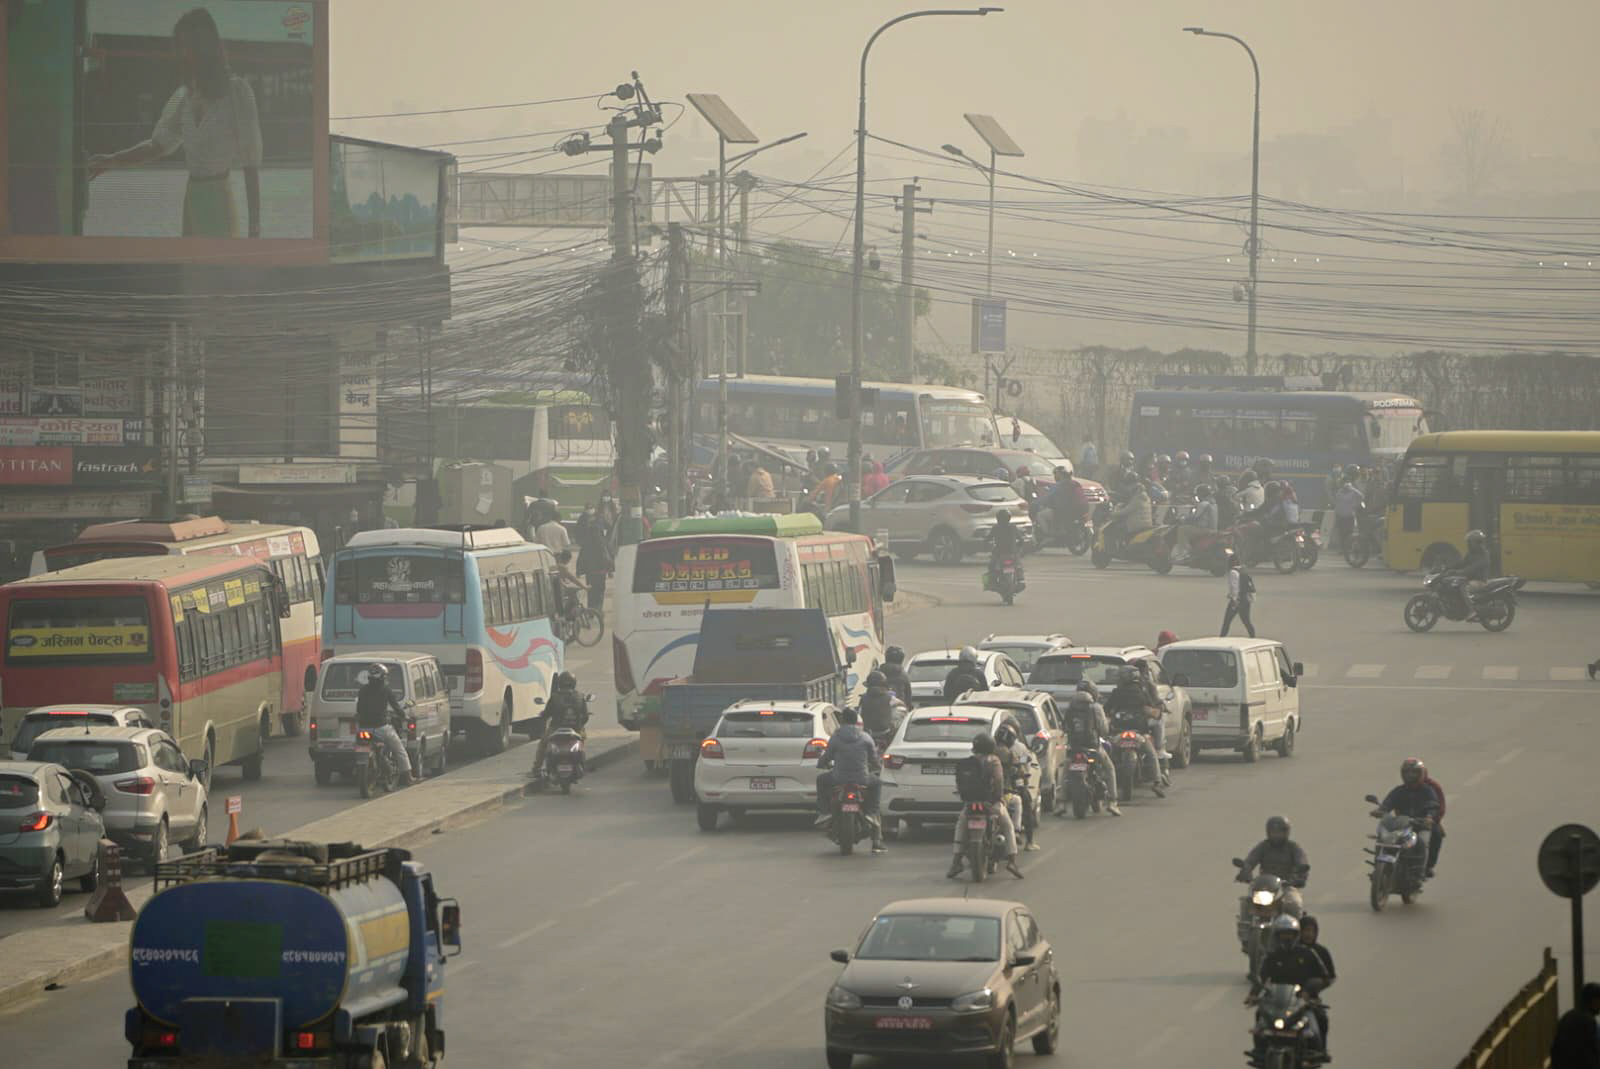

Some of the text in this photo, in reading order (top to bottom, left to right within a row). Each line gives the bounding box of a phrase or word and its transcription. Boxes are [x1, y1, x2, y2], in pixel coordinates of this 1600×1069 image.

[9, 459, 62, 472] TITAN
[76, 461, 139, 473] fastrack
[683, 547, 729, 560] LED
